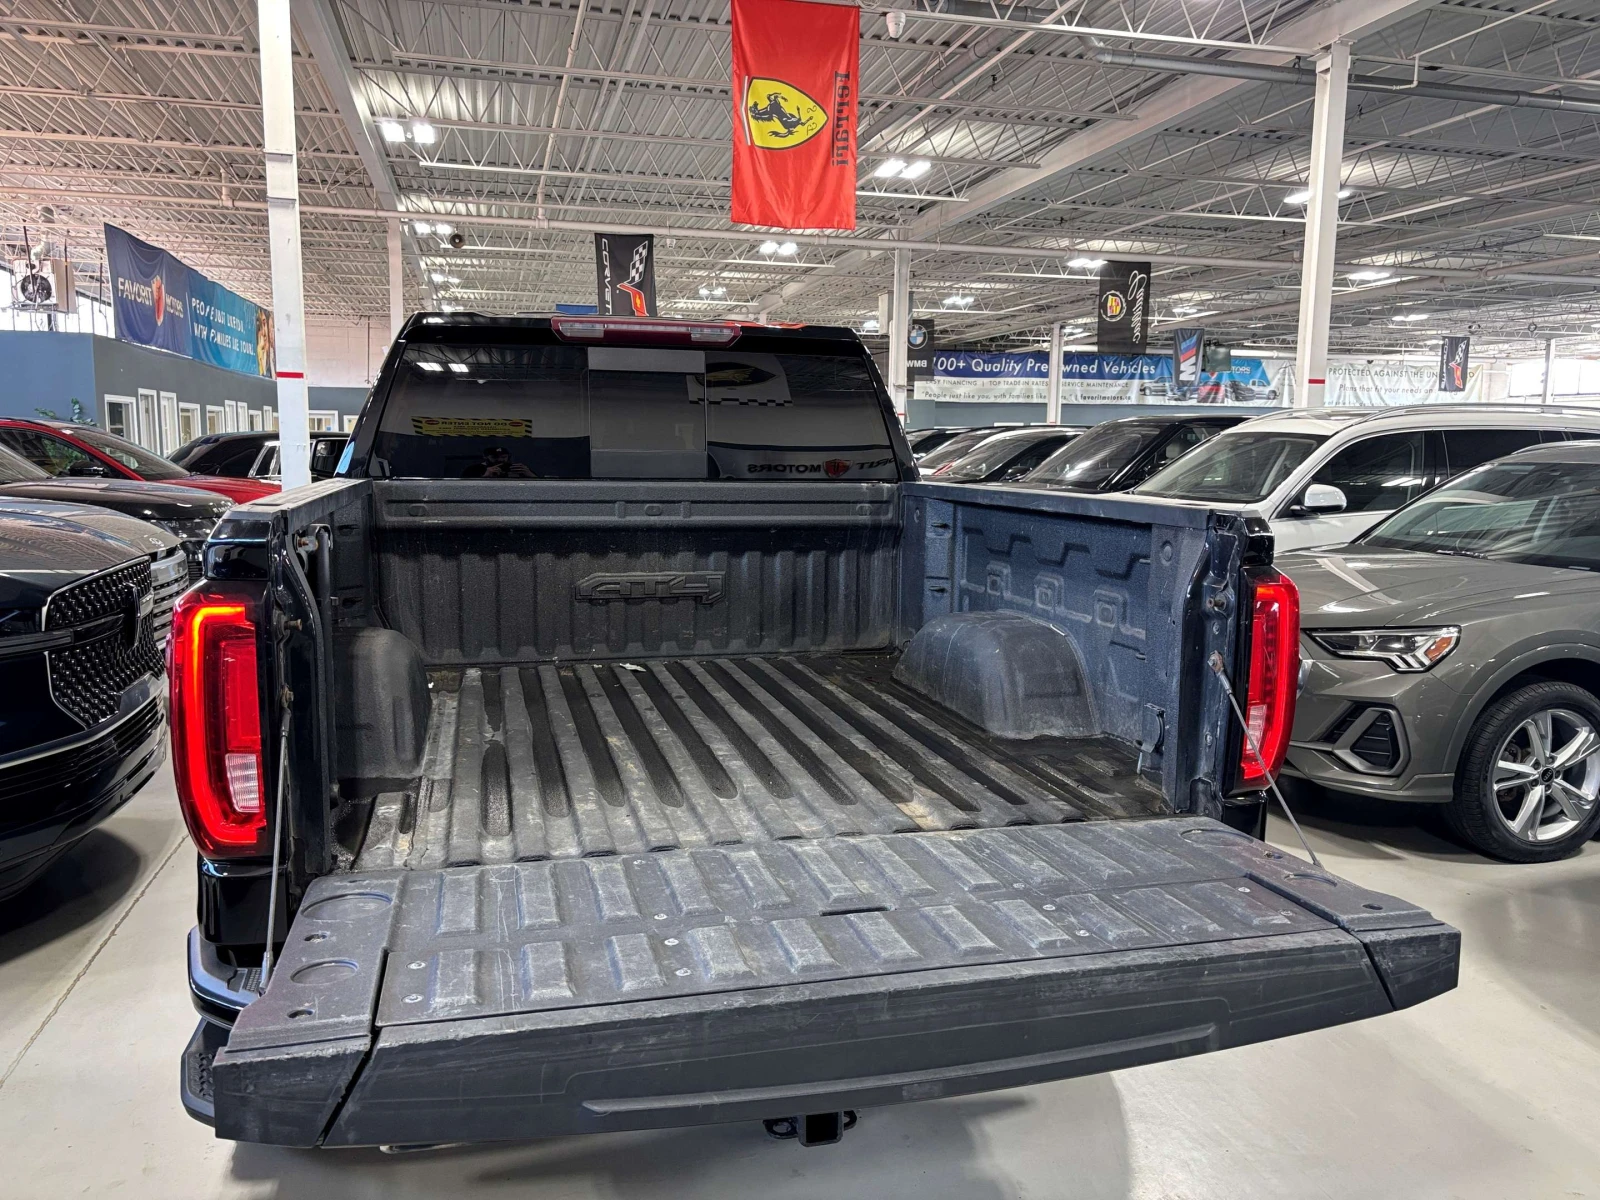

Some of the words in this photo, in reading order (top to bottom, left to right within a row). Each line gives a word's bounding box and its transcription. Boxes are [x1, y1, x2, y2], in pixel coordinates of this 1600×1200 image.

[118, 277, 152, 306] FAVORIT
[191, 297, 214, 320] PEOE
[971, 357, 1022, 375] Quality
[1026, 358, 1098, 373] Prewned
[1103, 359, 1156, 374] Vehicles
[1231, 365, 1251, 374] TORS
[1328, 367, 1371, 377] PROTECTED
[1373, 369, 1408, 378] AGAINST
[949, 392, 962, 400] just
[1339, 384, 1357, 392] Plans
[1384, 387, 1399, 395] your
[1401, 386, 1422, 394] needs
[578, 575, 723, 601] AT4
